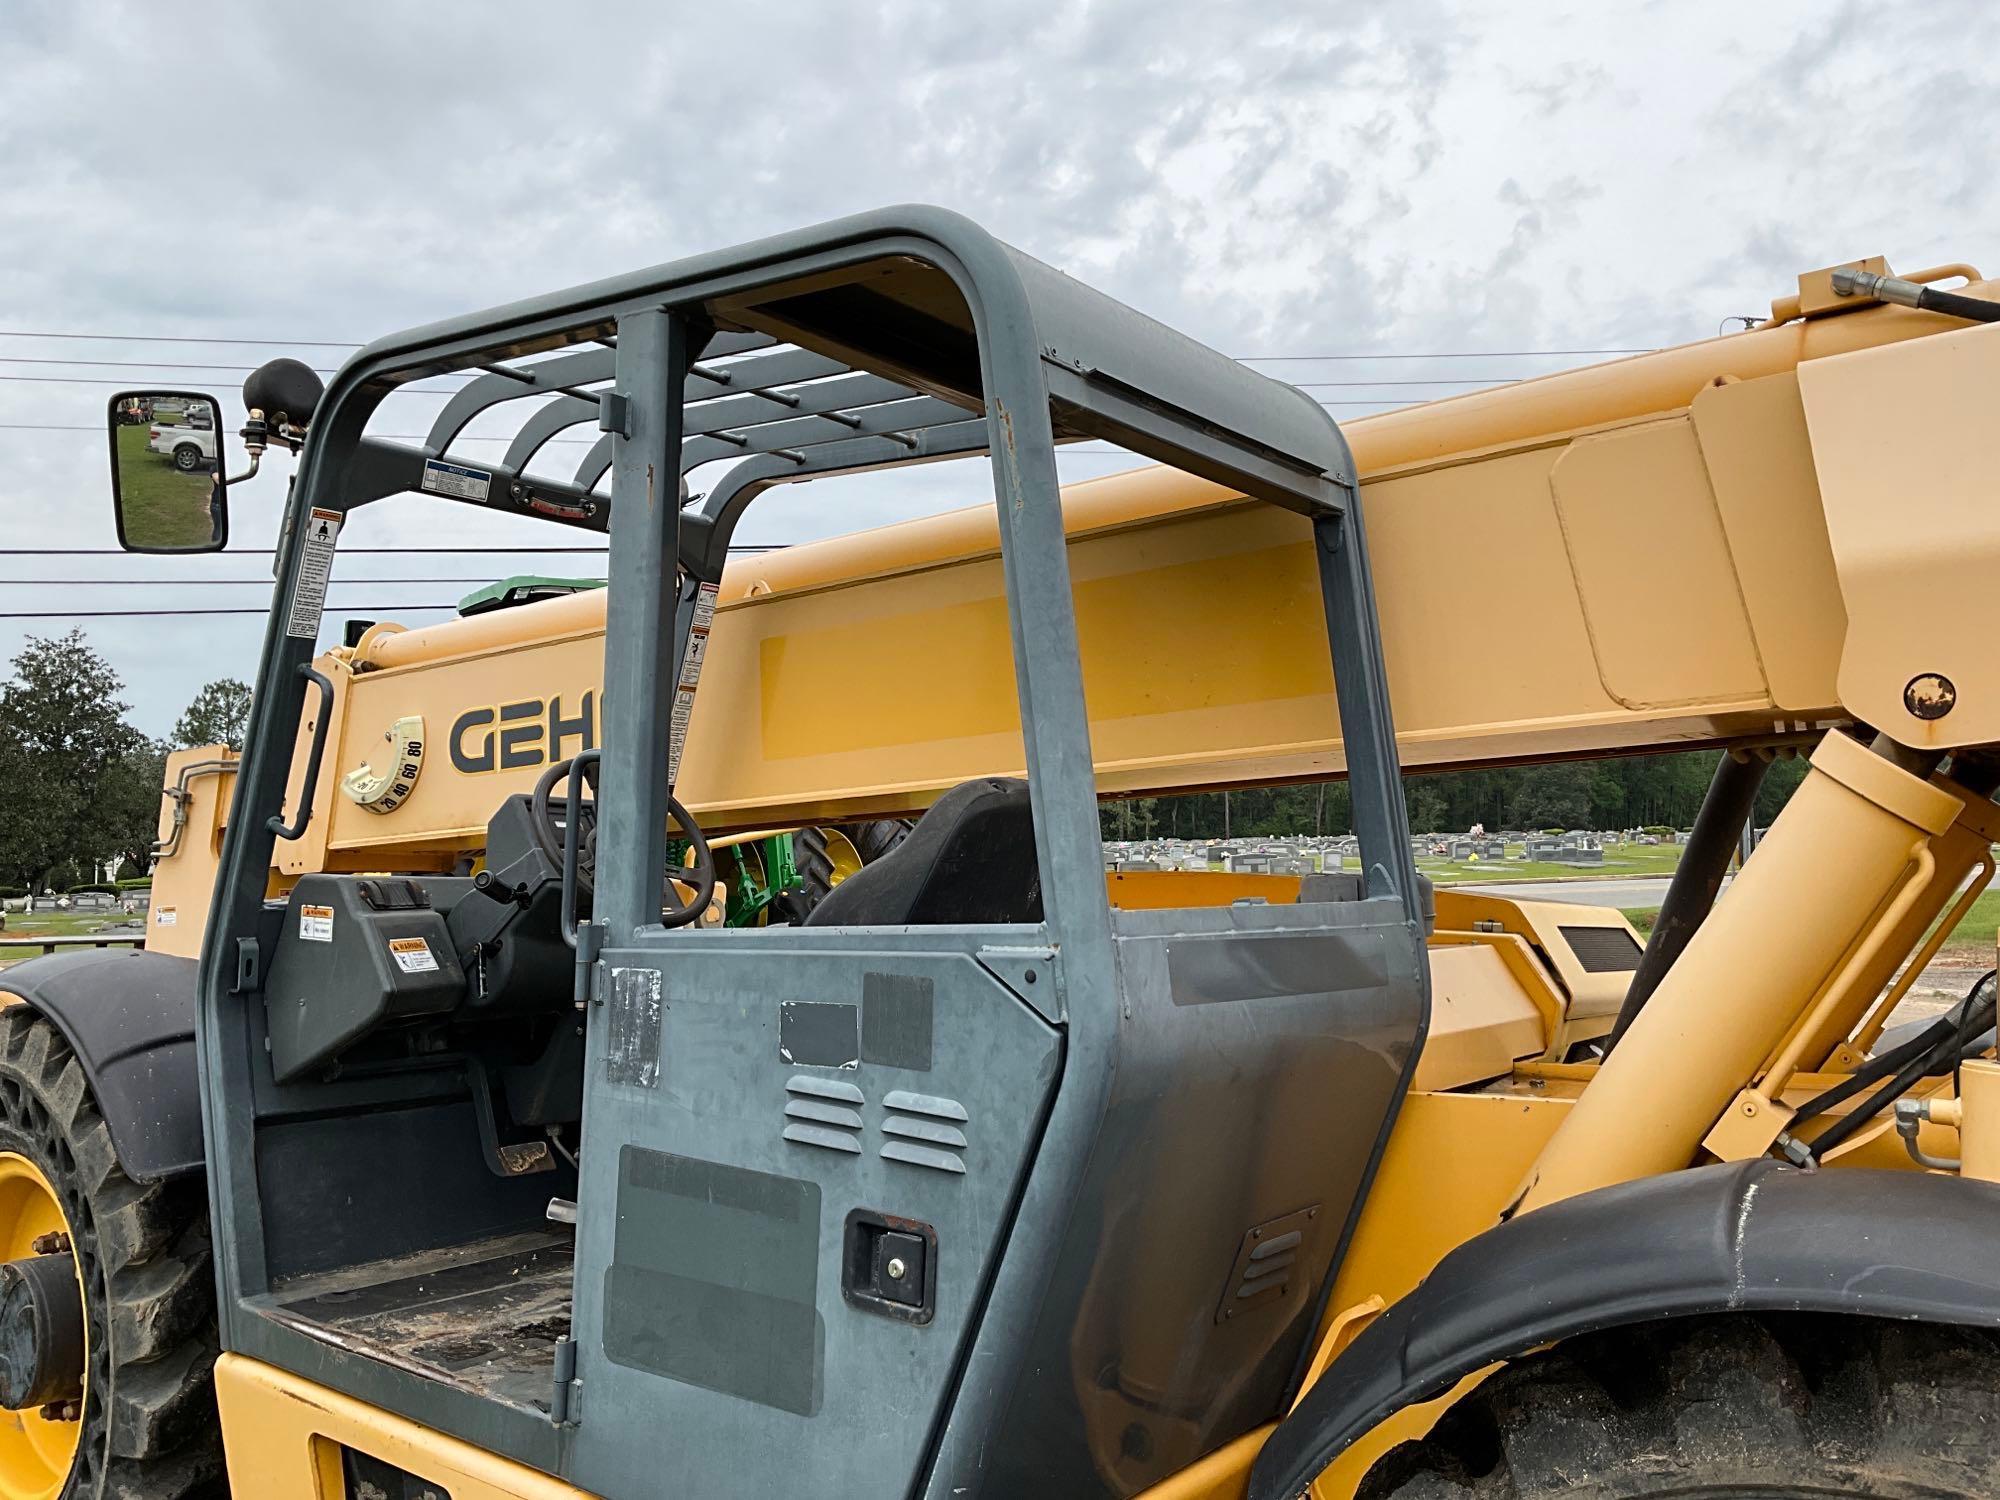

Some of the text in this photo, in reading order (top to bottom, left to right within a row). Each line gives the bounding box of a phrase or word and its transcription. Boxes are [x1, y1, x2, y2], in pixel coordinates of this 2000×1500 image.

[450, 690, 603, 773] GEH
[407, 741, 422, 757] 80
[402, 763, 418, 779] 60
[393, 783, 409, 797] 40
[380, 797, 397, 809] 20
[399, 941, 426, 950] WARNING
